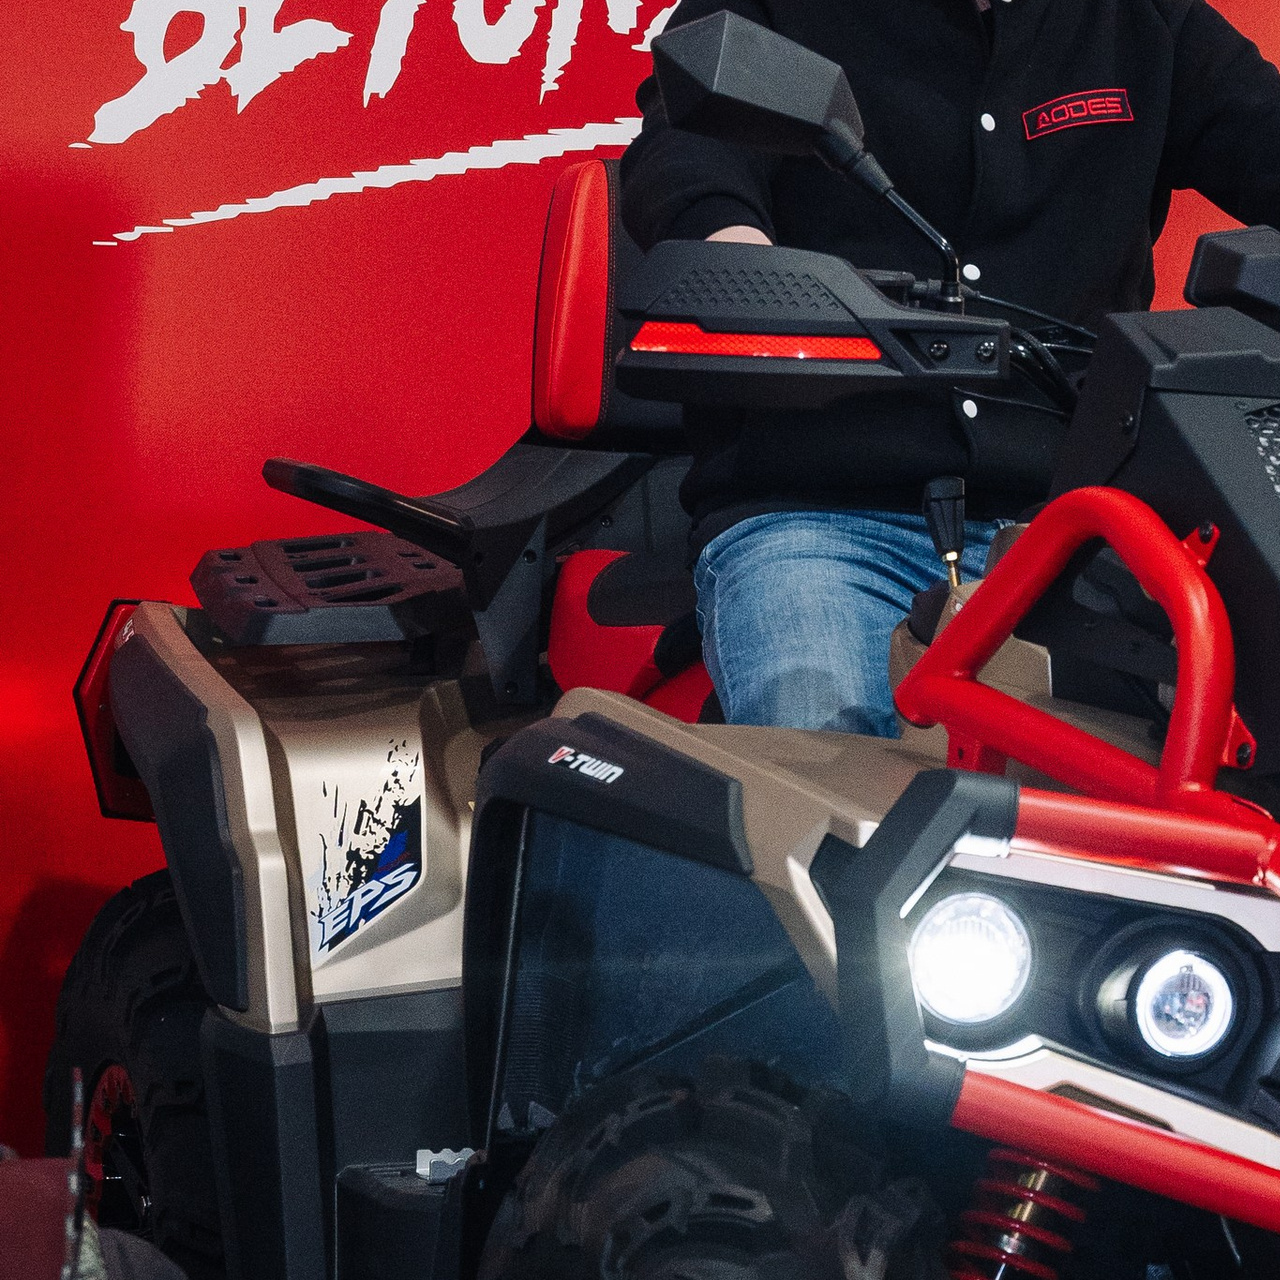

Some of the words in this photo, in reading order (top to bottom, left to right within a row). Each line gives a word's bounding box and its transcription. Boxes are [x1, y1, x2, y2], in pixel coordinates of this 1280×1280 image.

[1037, 97, 1123, 130] AODES
[548, 745, 625, 784] V-TWIN
[318, 862, 419, 948] EPS
